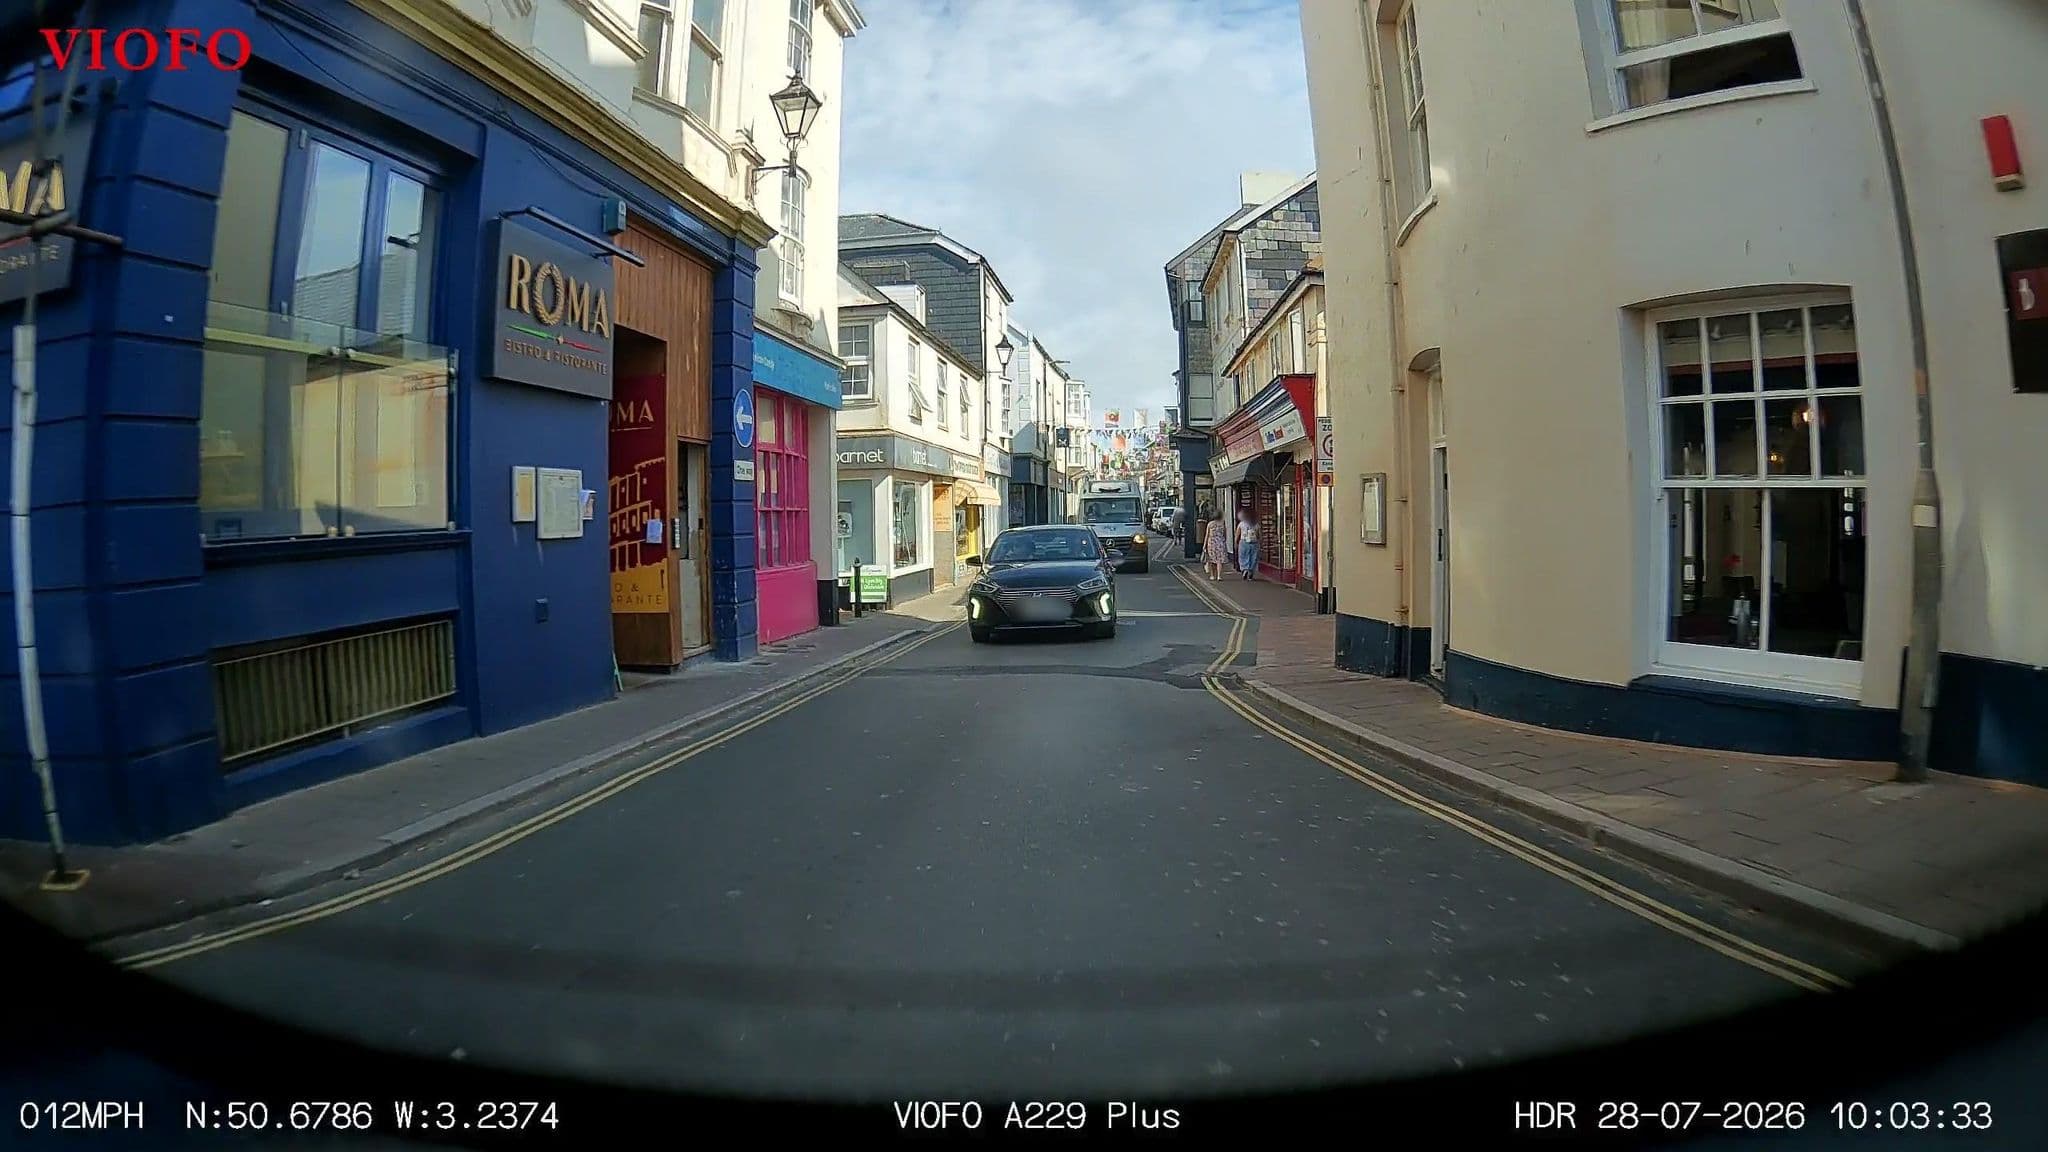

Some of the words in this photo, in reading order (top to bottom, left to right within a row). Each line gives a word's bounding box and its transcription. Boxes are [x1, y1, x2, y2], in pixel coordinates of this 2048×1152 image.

[509, 253, 609, 339] ROMA
[505, 338, 541, 360] BISTRO
[553, 351, 608, 375] RISTORANTE
